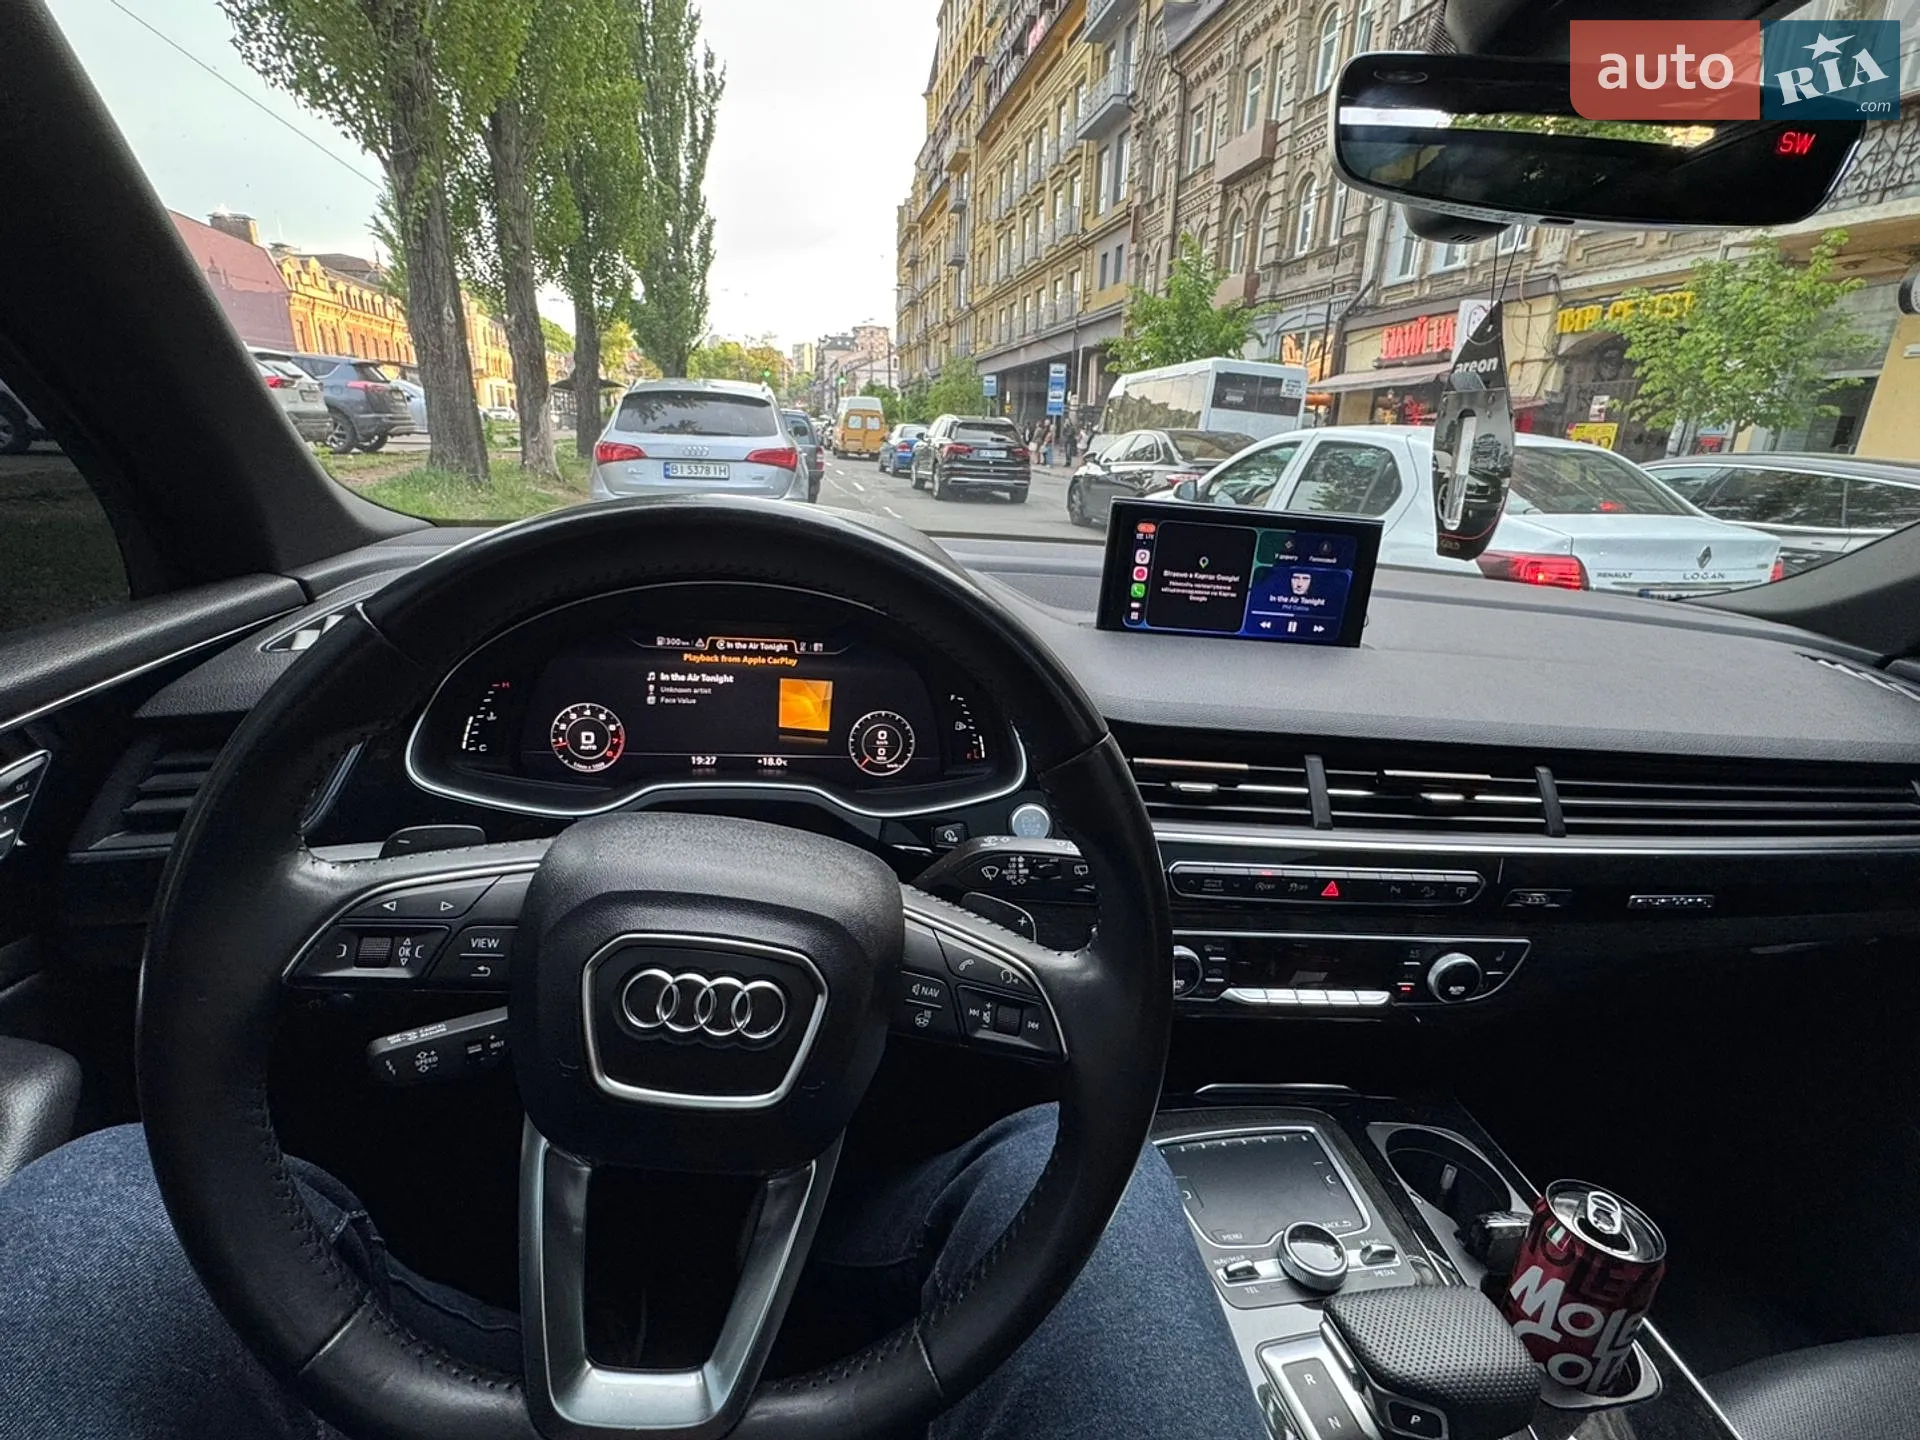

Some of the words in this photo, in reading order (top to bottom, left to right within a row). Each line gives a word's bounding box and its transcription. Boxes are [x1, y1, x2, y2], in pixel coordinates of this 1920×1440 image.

[1780, 132, 1816, 155] SW
[1455, 357, 1499, 373] areon
[1682, 572, 1726, 580] LOGAN
[727, 641, 734, 649] In
[735, 642, 747, 650] the
[749, 642, 759, 650] Air
[760, 643, 788, 651] Tonight
[683, 653, 719, 664] Playback
[721, 655, 740, 664] from
[742, 656, 766, 666] Apple
[767, 656, 798, 667] CarPlay
[660, 672, 670, 682] In
[671, 672, 685, 682] the
[687, 673, 699, 682] Air
[701, 674, 734, 684] Tonight
[660, 686, 692, 694] Unknown
[580, 732, 595, 745] D
[691, 756, 717, 766] 19:27
[471, 938, 499, 948] VIEW
[399, 947, 411, 957] OK
[921, 986, 940, 998] NAV
[1222, 1233, 1243, 1241] MENU
[1245, 1286, 1259, 1294] TEL
[1304, 1373, 1317, 1385] R
[1328, 1416, 1342, 1429] N
[1410, 1415, 1421, 1425] P
